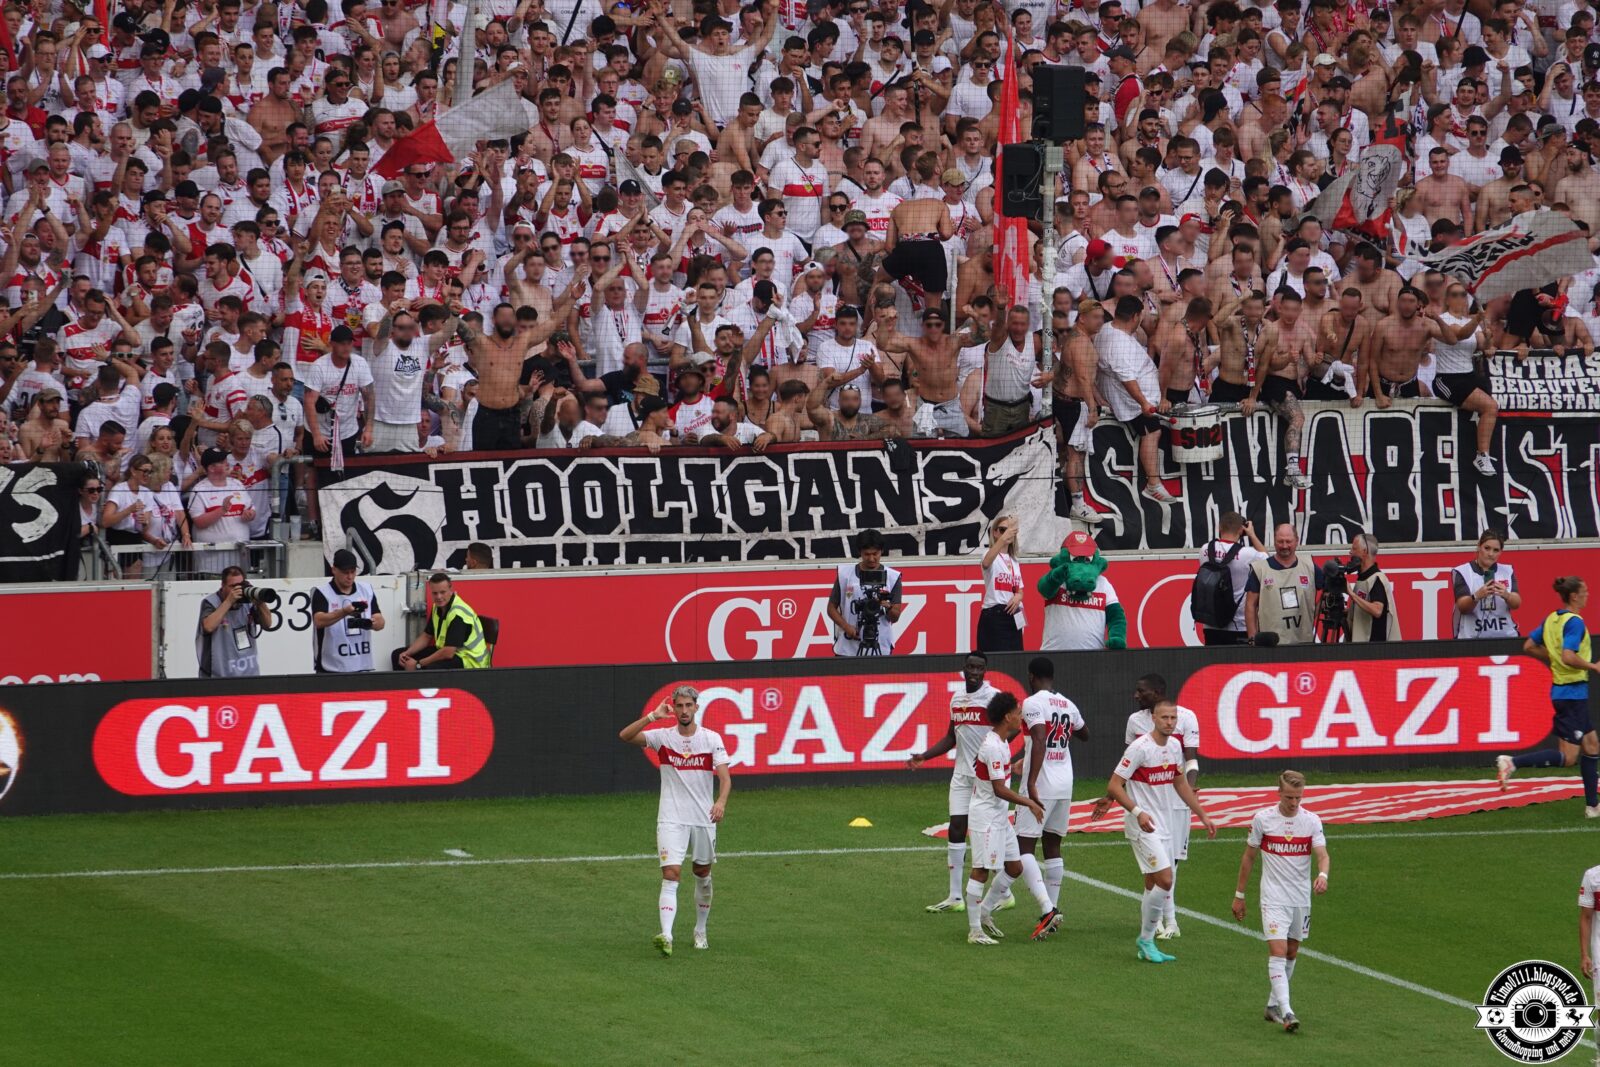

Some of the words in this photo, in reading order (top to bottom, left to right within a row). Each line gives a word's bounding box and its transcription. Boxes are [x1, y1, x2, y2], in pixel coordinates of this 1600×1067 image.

[1487, 352, 1600, 379] ULTRAS
[430, 452, 984, 543] HOOLIGANS
[1282, 615, 1302, 630] TV
[1474, 617, 1507, 633] SMF
[337, 641, 371, 657] CLUB
[1046, 711, 1073, 749] 23
[1267, 841, 1308, 853] WINAMAX
